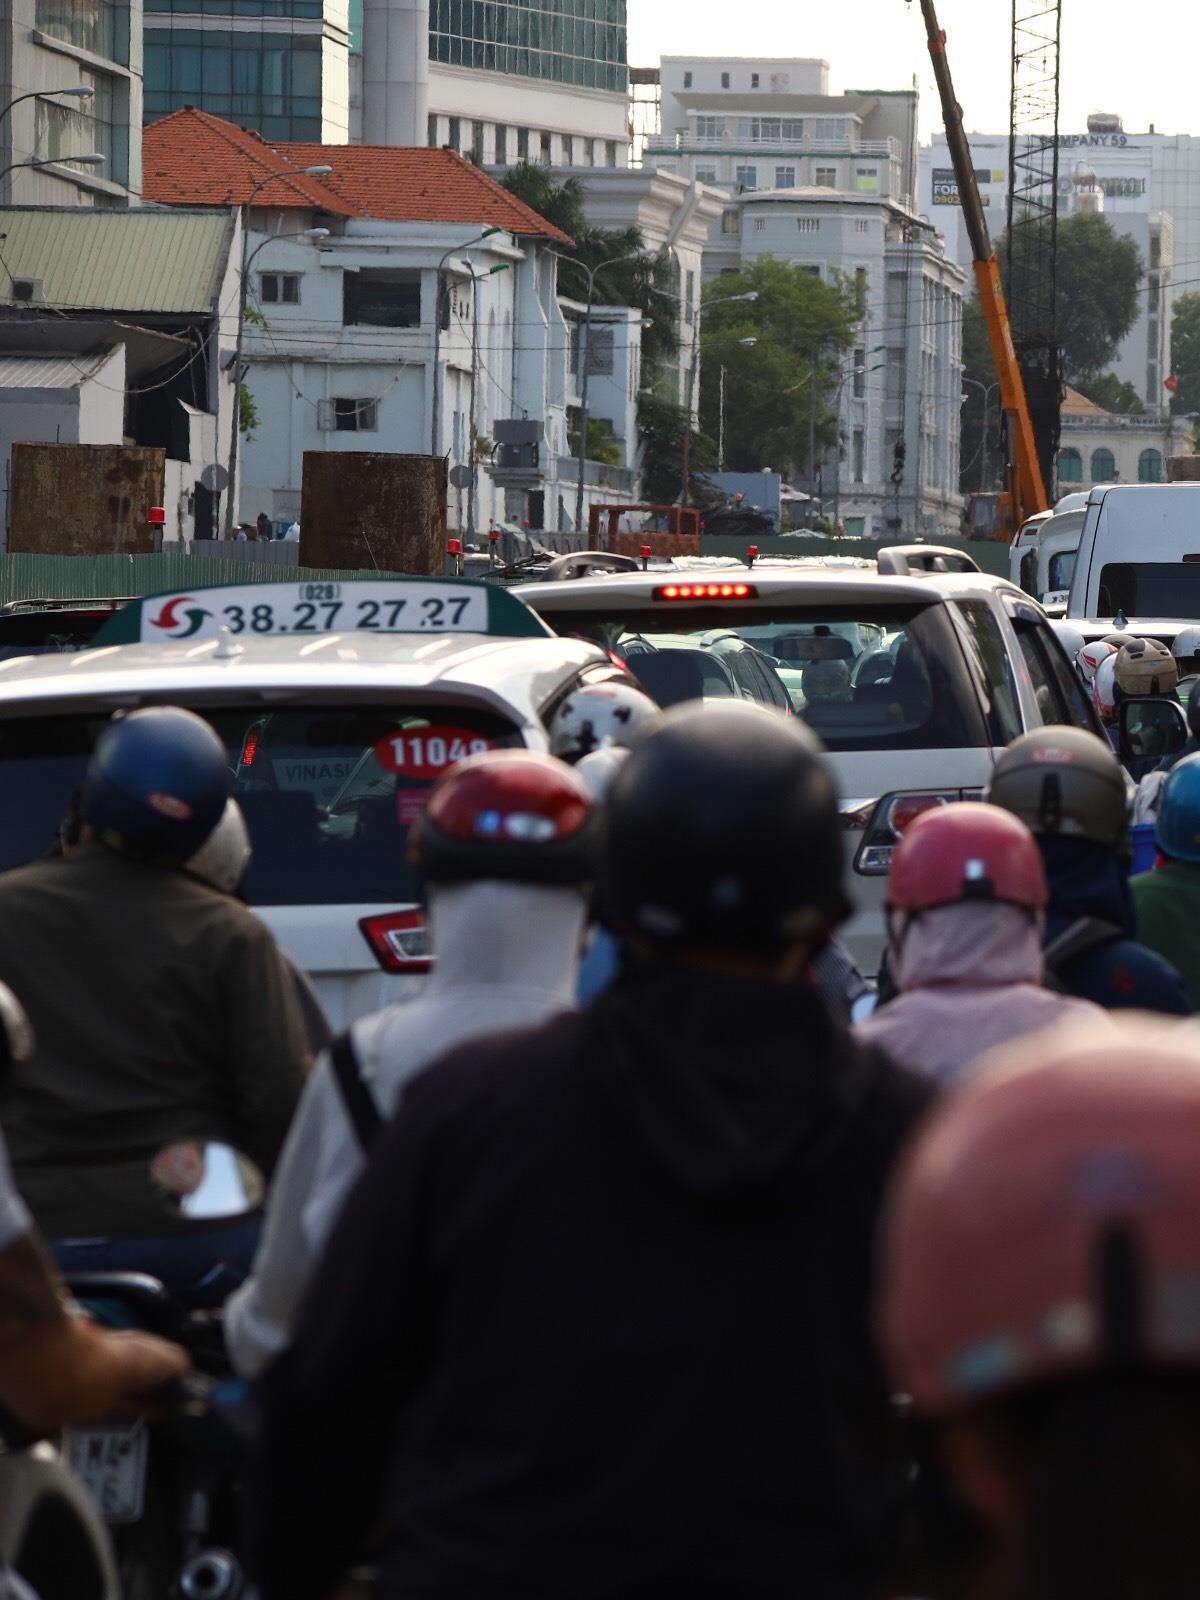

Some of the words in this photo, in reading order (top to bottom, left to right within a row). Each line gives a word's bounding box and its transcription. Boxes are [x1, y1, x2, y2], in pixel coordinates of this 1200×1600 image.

[1040, 135, 1108, 146] CMPANY
[1111, 135, 1127, 147] 59
[298, 583, 341, 600] (028)
[221, 601, 343, 635] 38.27
[356, 599, 408, 629] 27
[419, 597, 471, 628] 27
